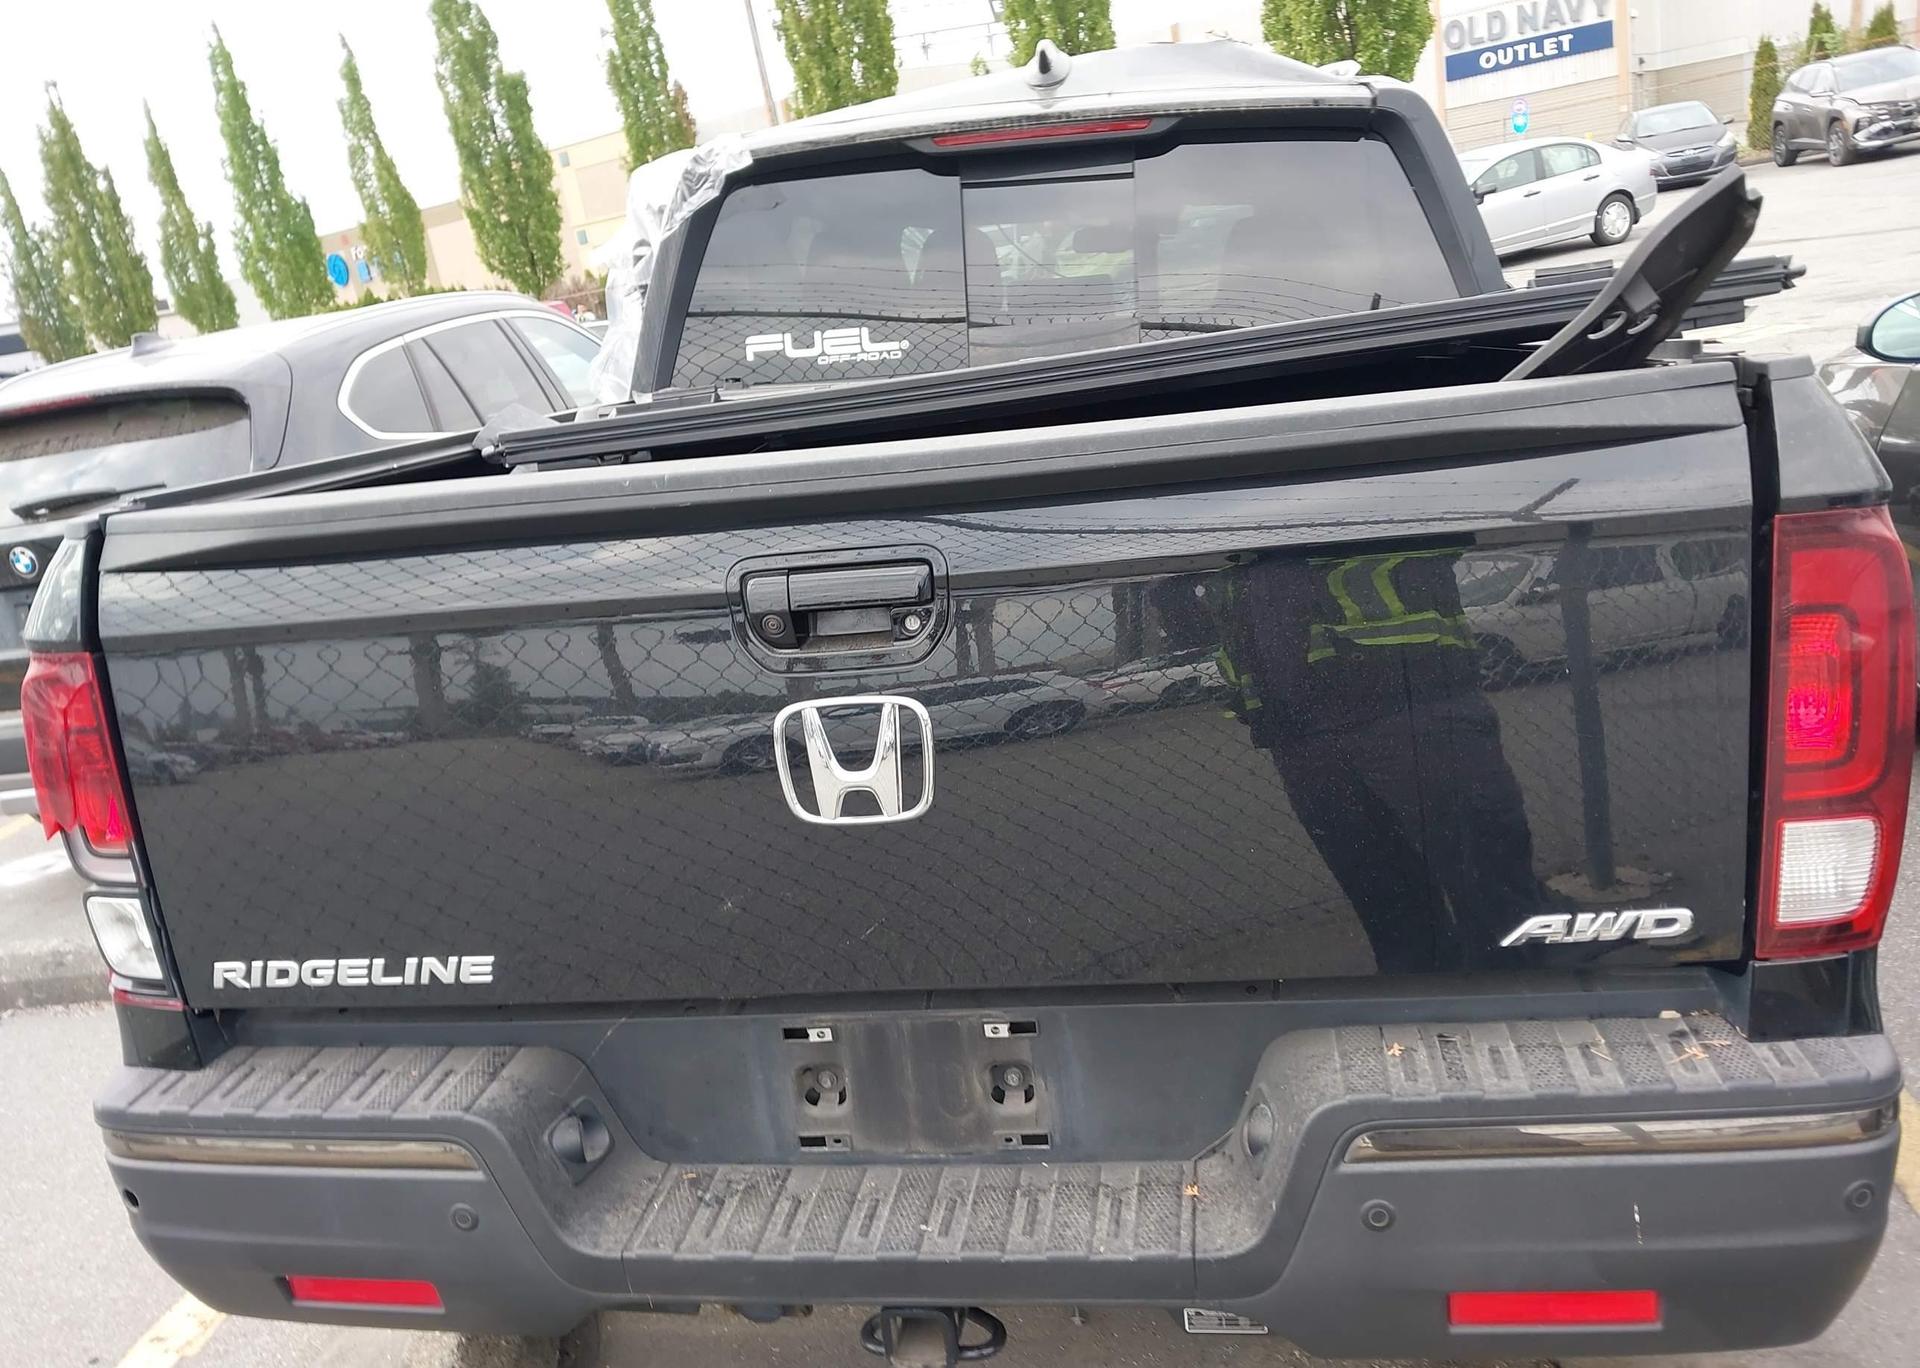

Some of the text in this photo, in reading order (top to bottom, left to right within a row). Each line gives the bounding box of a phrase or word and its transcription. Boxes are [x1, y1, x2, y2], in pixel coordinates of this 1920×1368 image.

[1444, 10, 1507, 50] OLD
[1479, 34, 1574, 69] OUTLET
[745, 327, 900, 361] FUEL
[817, 350, 902, 365] OFF-ROAD
[1500, 908, 1695, 947] AWD
[213, 956, 495, 989] RIDGELINE
